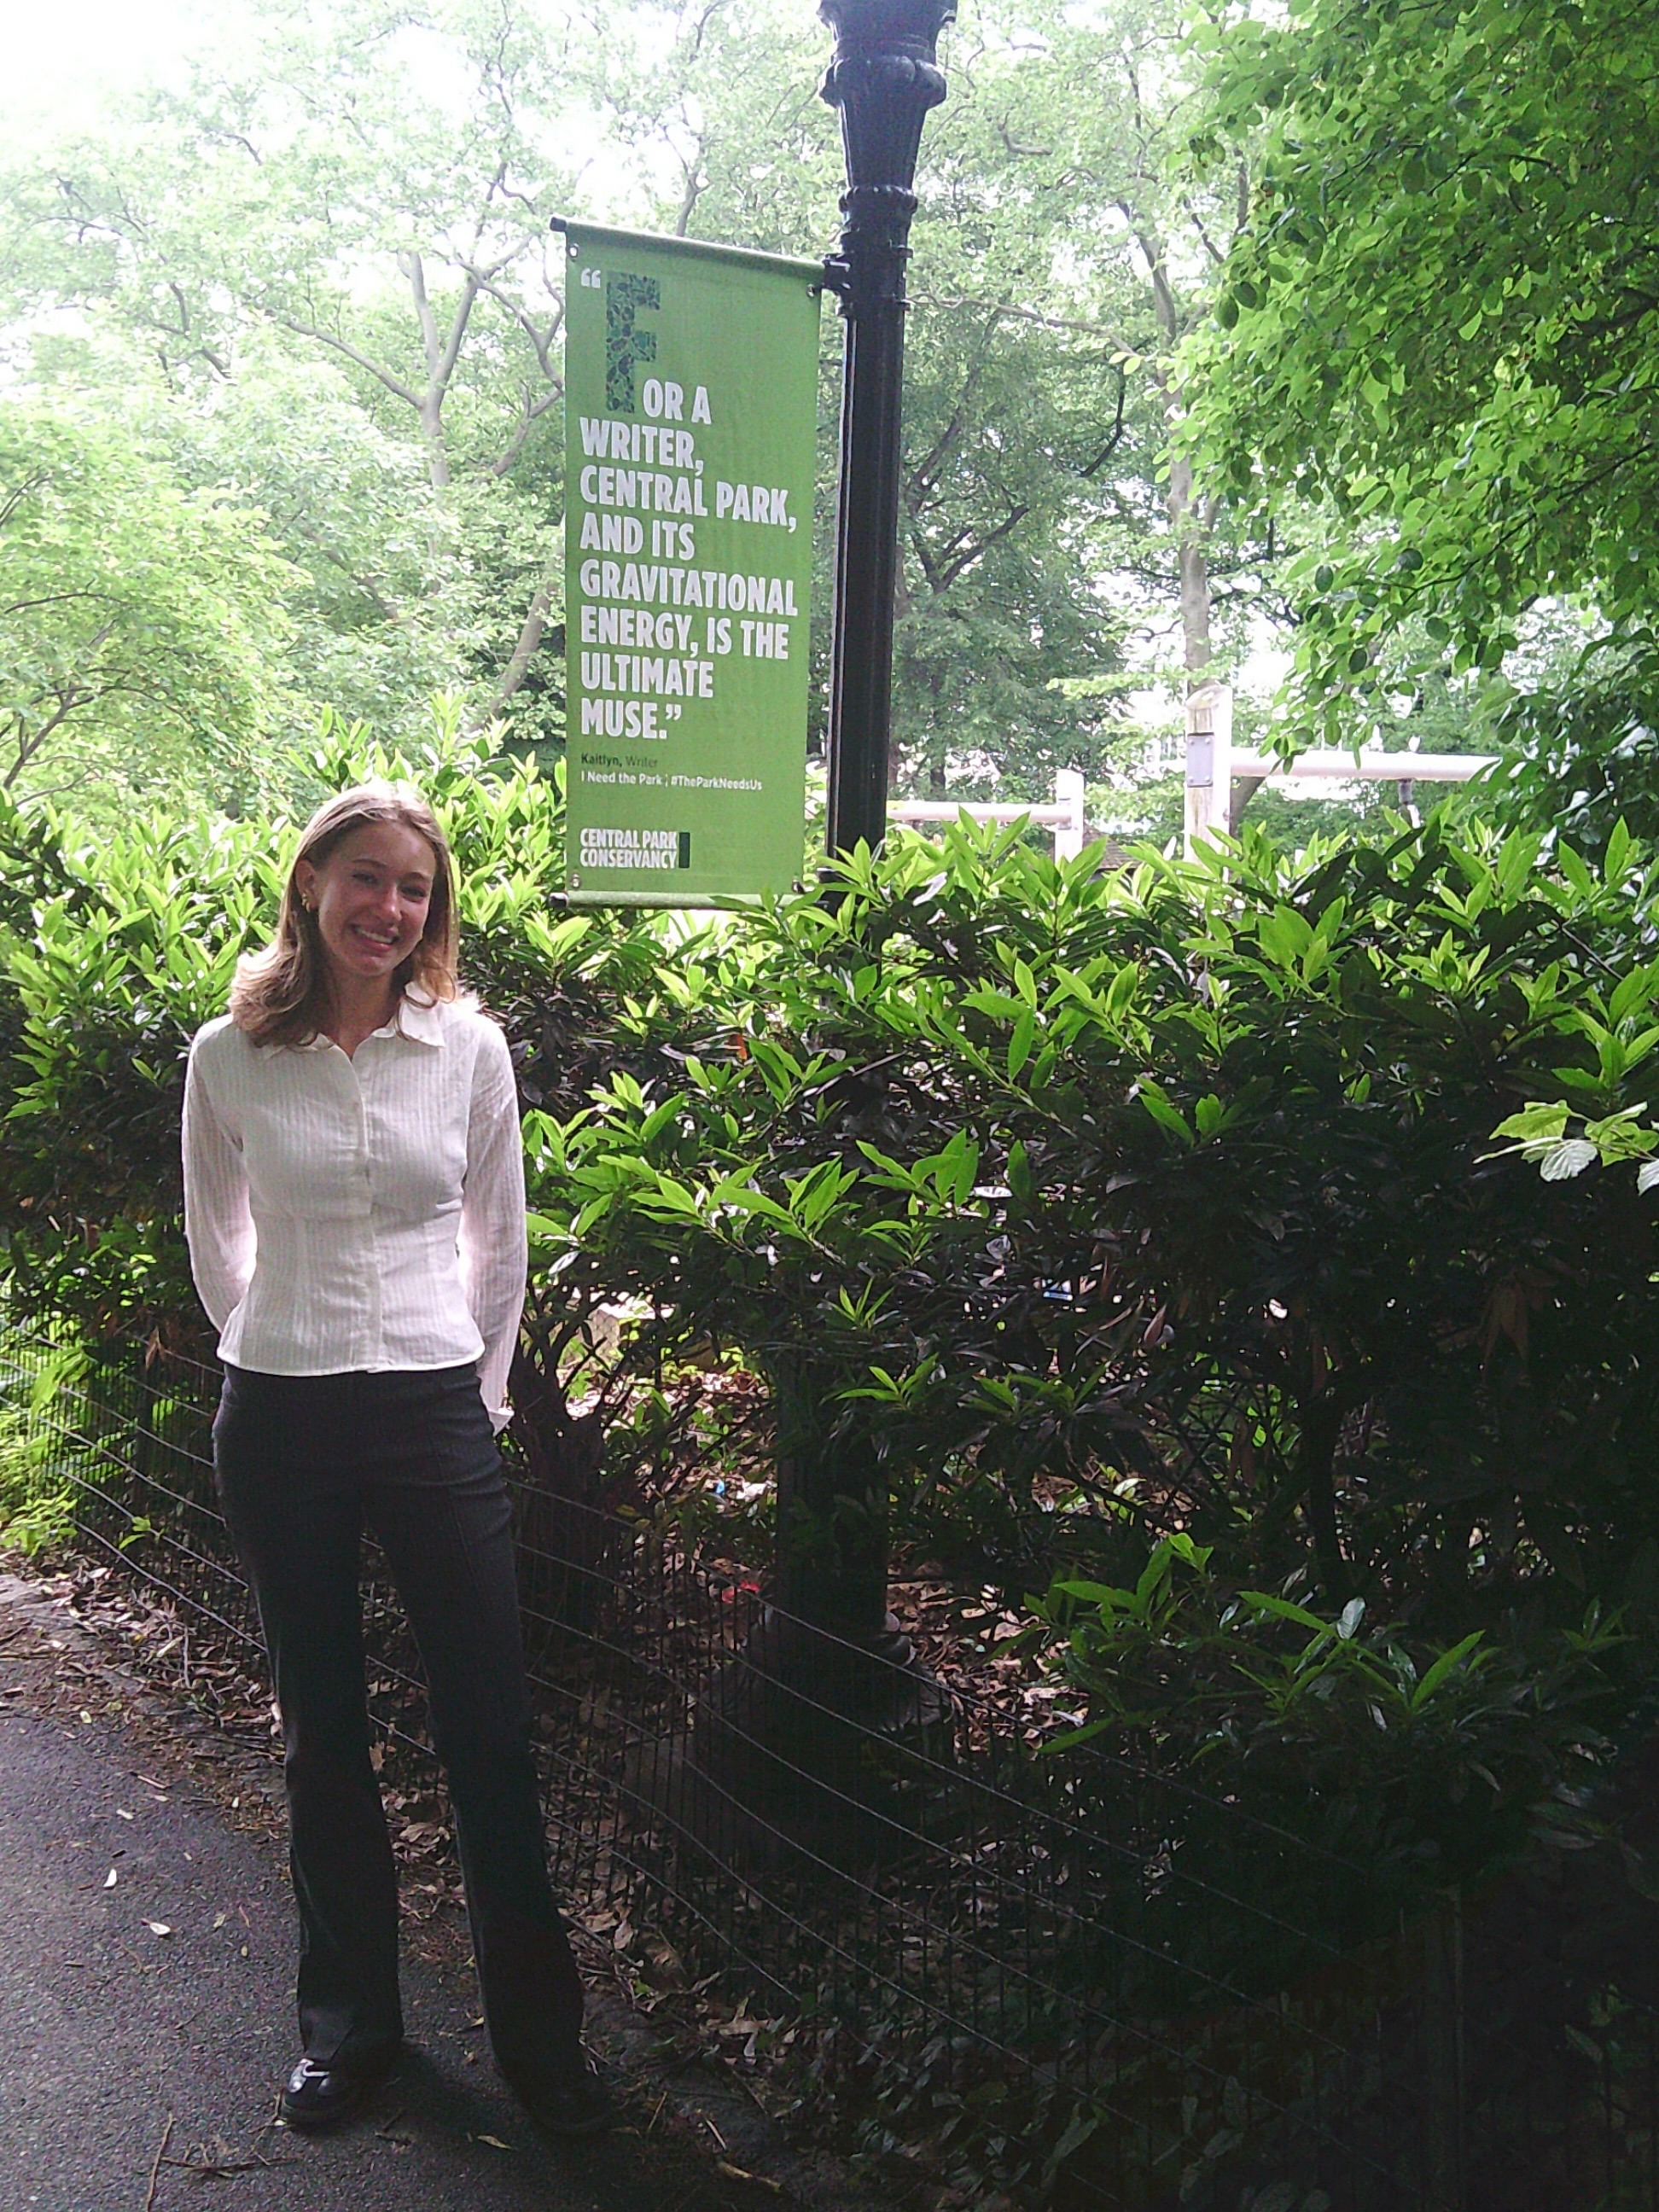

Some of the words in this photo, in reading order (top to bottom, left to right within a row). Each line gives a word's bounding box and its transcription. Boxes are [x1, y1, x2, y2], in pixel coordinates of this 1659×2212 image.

[690, 386, 712, 425] A
[579, 416, 704, 475] WRITER,
[579, 464, 708, 516] CENTRAL
[716, 480, 797, 533] PARK,
[579, 512, 644, 554] AND
[651, 519, 696, 561] ITS
[579, 559, 798, 616] GRAVITATIONAL
[580, 605, 700, 658] ENERGY,
[707, 616, 732, 655] IS
[740, 620, 789, 660] THE
[580, 651, 714, 698] ULTIMATE
[580, 771, 585, 782] I
[587, 771, 615, 783] Need
[619, 772, 637, 785] the
[639, 773, 662, 786] Park
[671, 775, 763, 791] #TheParkNeedsUs
[581, 753, 623, 768] Kaitlyn,
[625, 755, 658, 768] Writer
[579, 828, 640, 848] CENTRAL
[642, 830, 677, 849] PARK
[579, 849, 677, 869] CONSERVANCY
